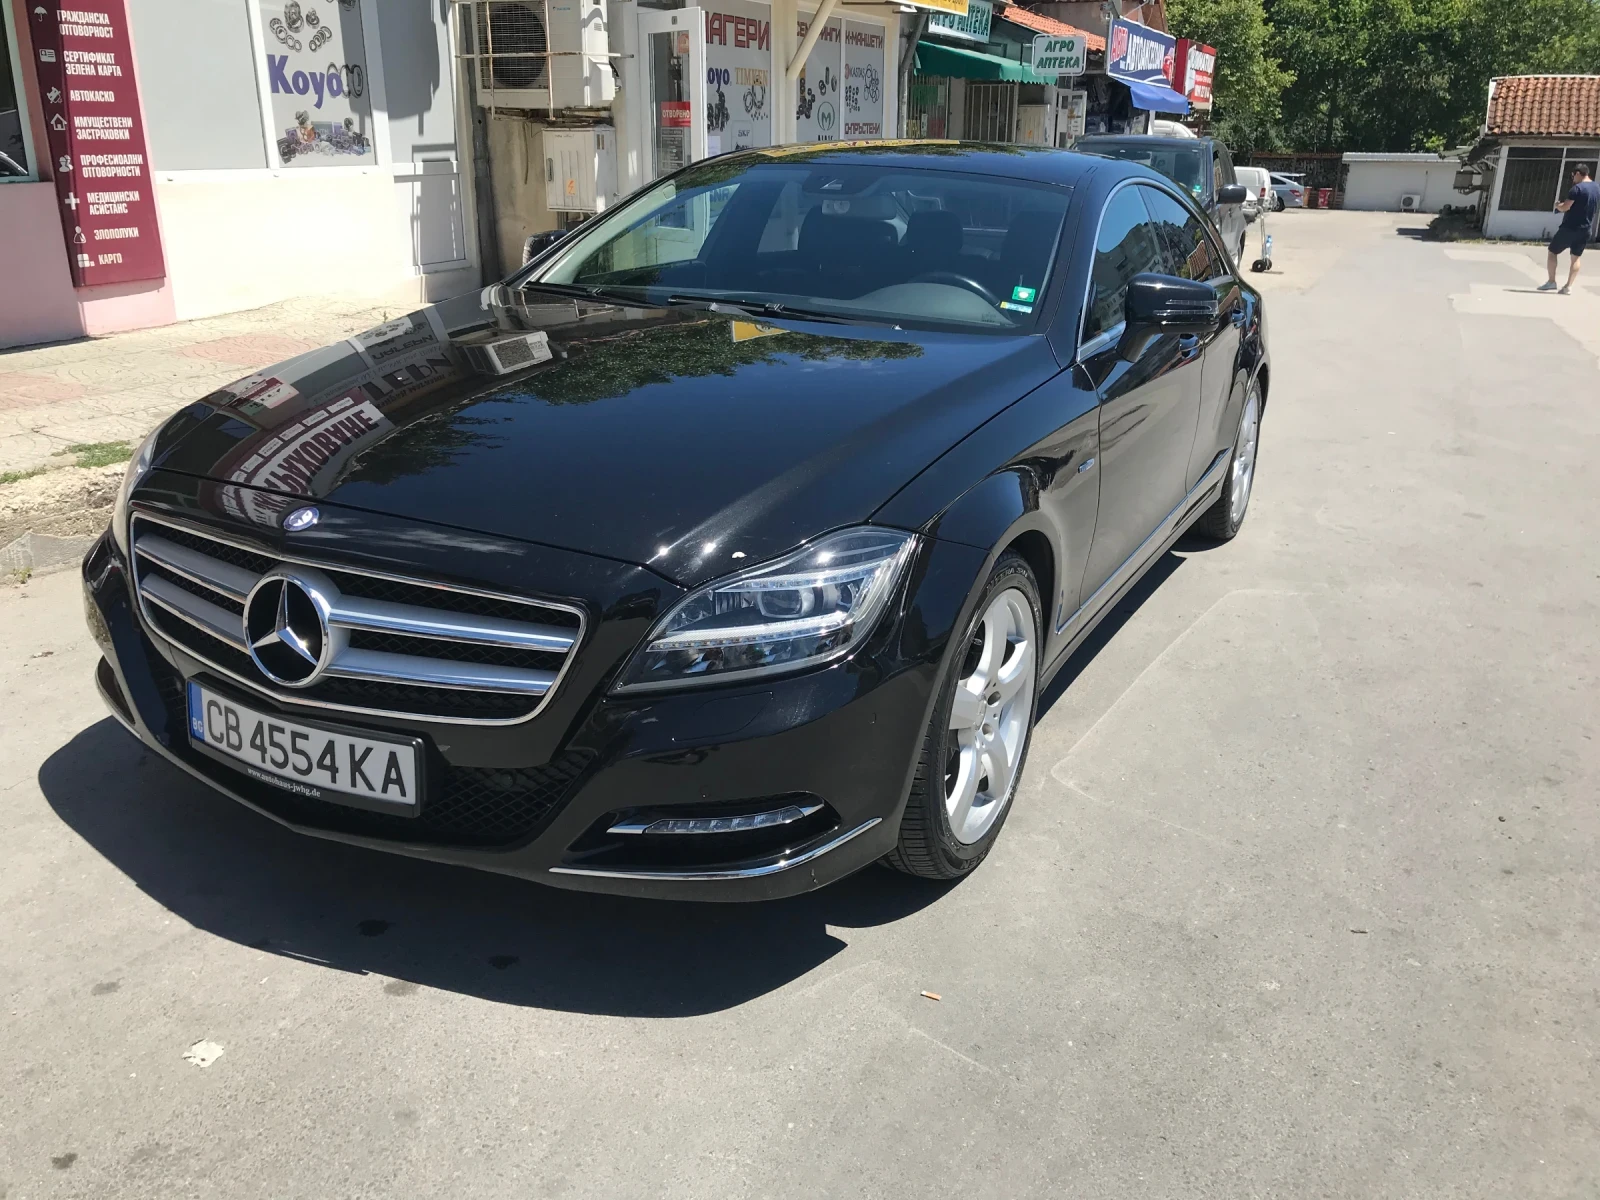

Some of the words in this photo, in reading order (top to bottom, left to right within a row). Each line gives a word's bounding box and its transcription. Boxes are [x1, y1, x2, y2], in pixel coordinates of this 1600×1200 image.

[57, 10, 110, 25] ГРАЖДАНСКА
[59, 24, 113, 38] ОТГОВОРНОСТ
[705, 11, 769, 51] АГЕРИ
[1045, 40, 1074, 52] АГРО
[64, 50, 115, 64] СЕРТИФИКАТ
[1036, 57, 1080, 69] АПТЕКА
[66, 63, 96, 76] ЗЕЛЕНА
[97, 64, 122, 77] КАРТА
[267, 54, 343, 109] Koyo
[707, 67, 731, 93] oyo
[70, 90, 115, 102] АВТОКАСКО
[662, 109, 690, 118] ОТВОРЕНО
[74, 117, 133, 129] ИМУЩЕСТВЕНИ
[76, 128, 130, 140] ЗАСТРАХОВКИ
[82, 165, 141, 178] ОТГОВОРНОСТИ
[87, 191, 140, 204] МЕДИЦИНСКИ
[89, 203, 128, 215] АСИСТАНС
[94, 227, 139, 240] ЗЛОПОЛУКИ
[98, 253, 122, 265] КАРГО
[192, 717, 203, 733] BG
[206, 700, 242, 752] CB
[250, 721, 339, 784] 4554
[349, 743, 407, 798] KA
[247, 766, 321, 798] www.autohaus-jwhg.de
